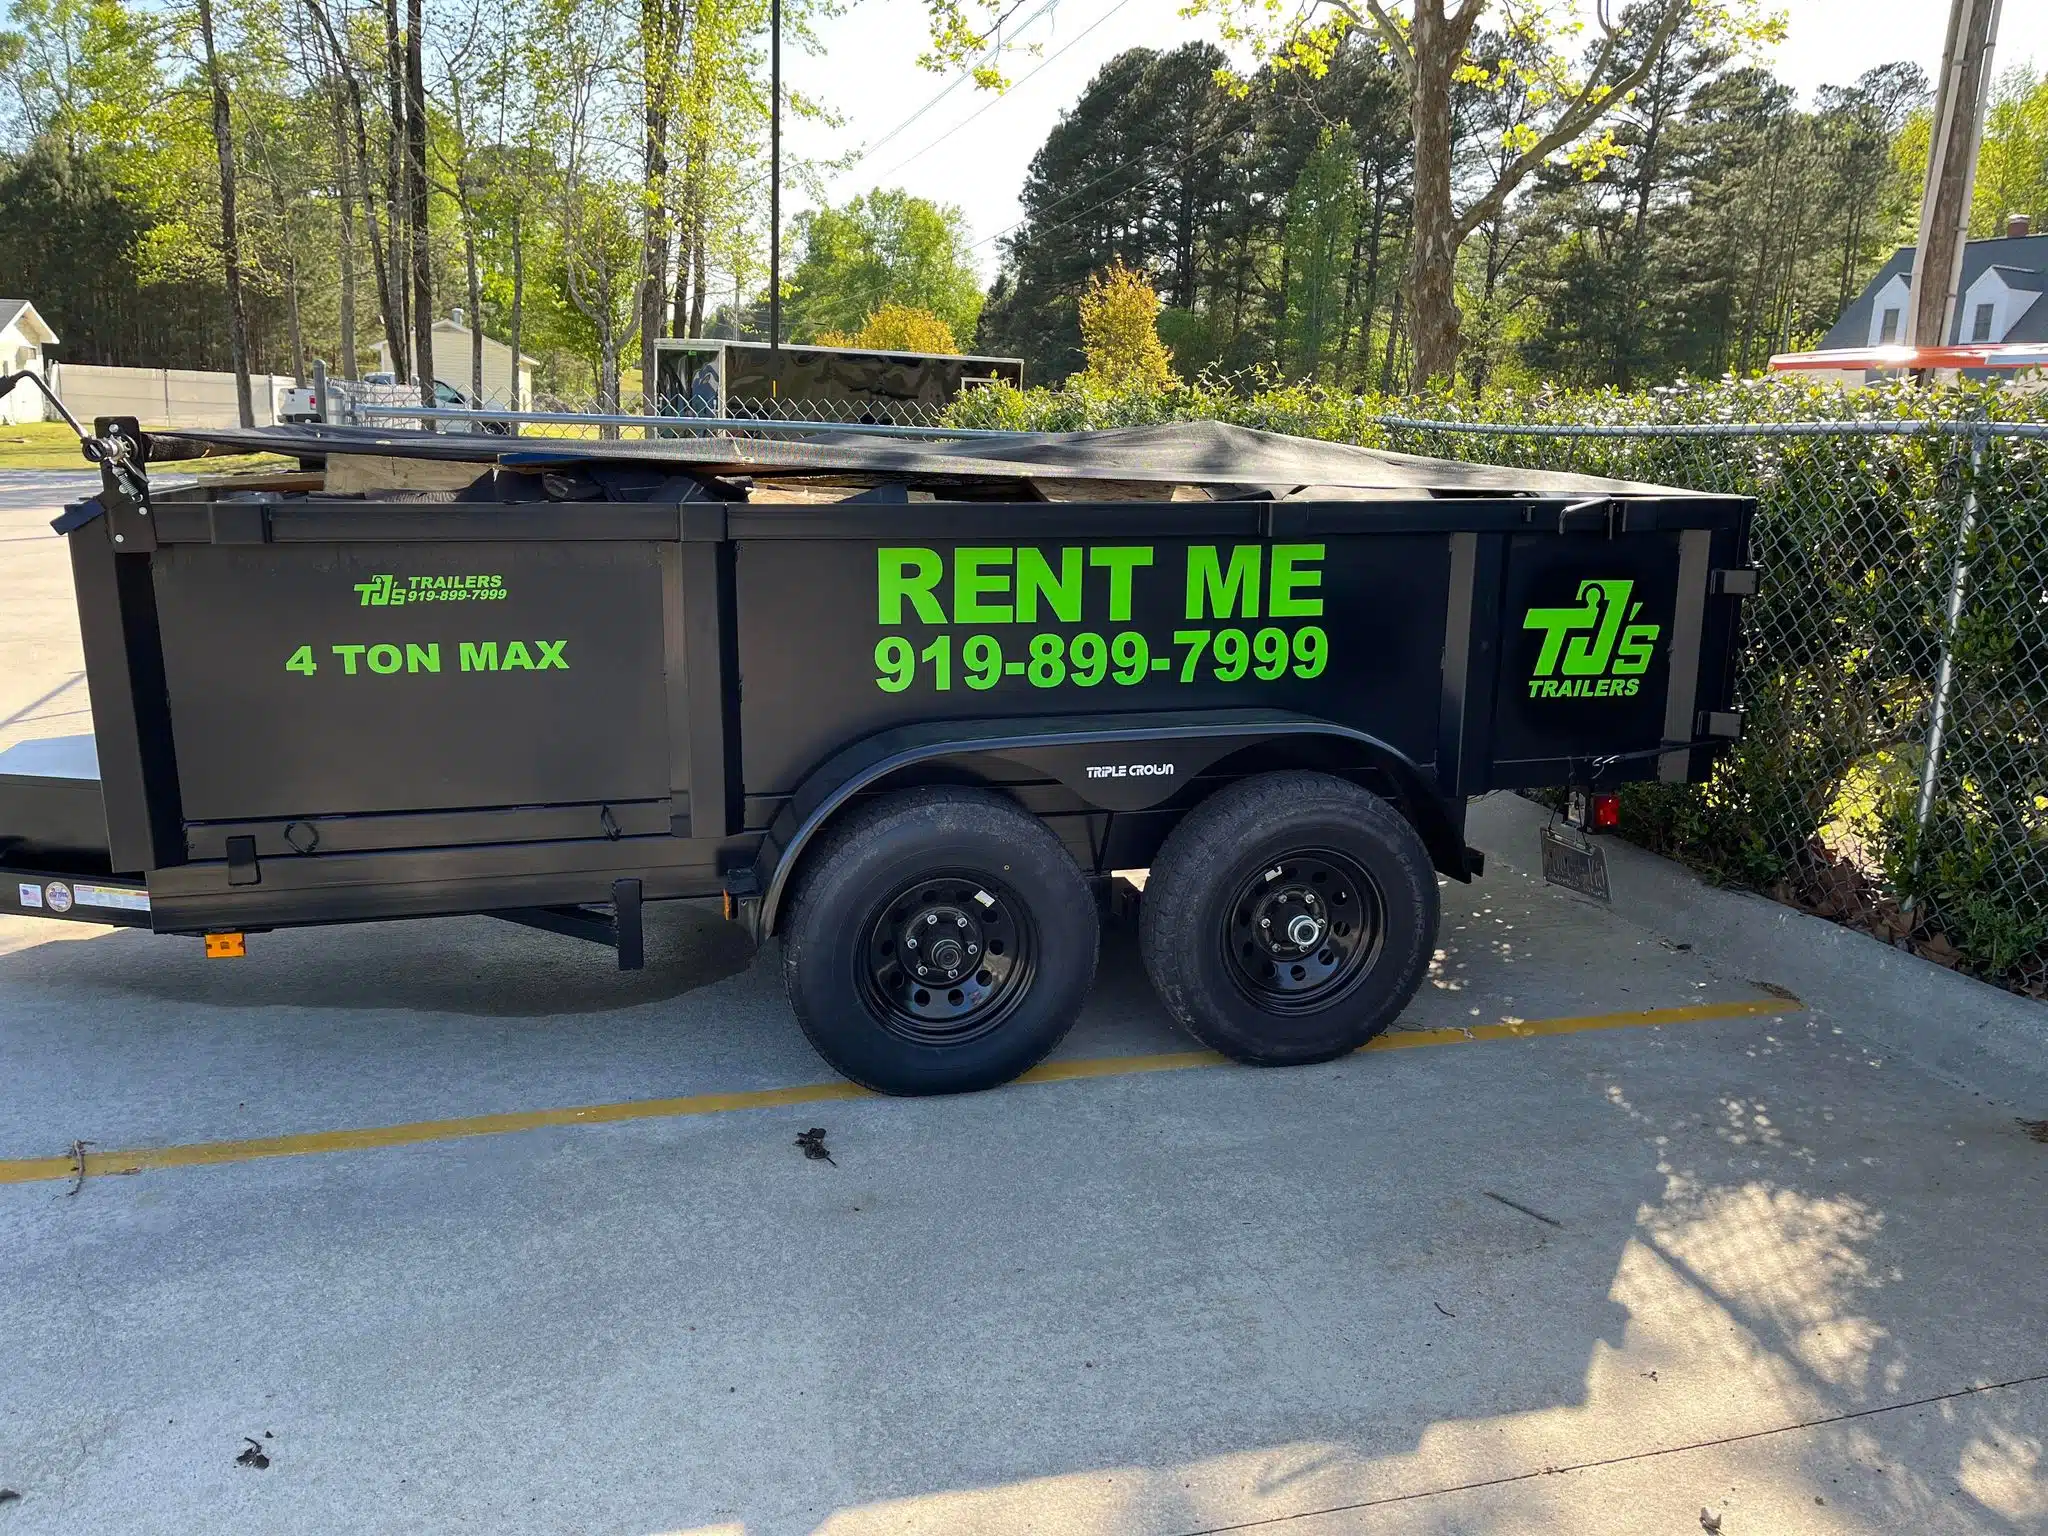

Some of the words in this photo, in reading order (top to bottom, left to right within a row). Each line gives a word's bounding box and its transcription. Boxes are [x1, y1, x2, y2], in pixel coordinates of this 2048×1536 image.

[408, 575, 502, 589] TRAILERS
[878, 546, 1154, 624] RENT
[1185, 543, 1327, 620] ME
[408, 589, 507, 602] 919-899-7999
[286, 645, 317, 675] 4
[332, 643, 441, 674] TON
[459, 640, 570, 671] MAX
[875, 627, 1330, 692] 919-899-7999
[1528, 679, 1640, 698] TRAILERS
[1086, 765, 1127, 778] TRIPLE
[1128, 764, 1174, 776] CROWN
